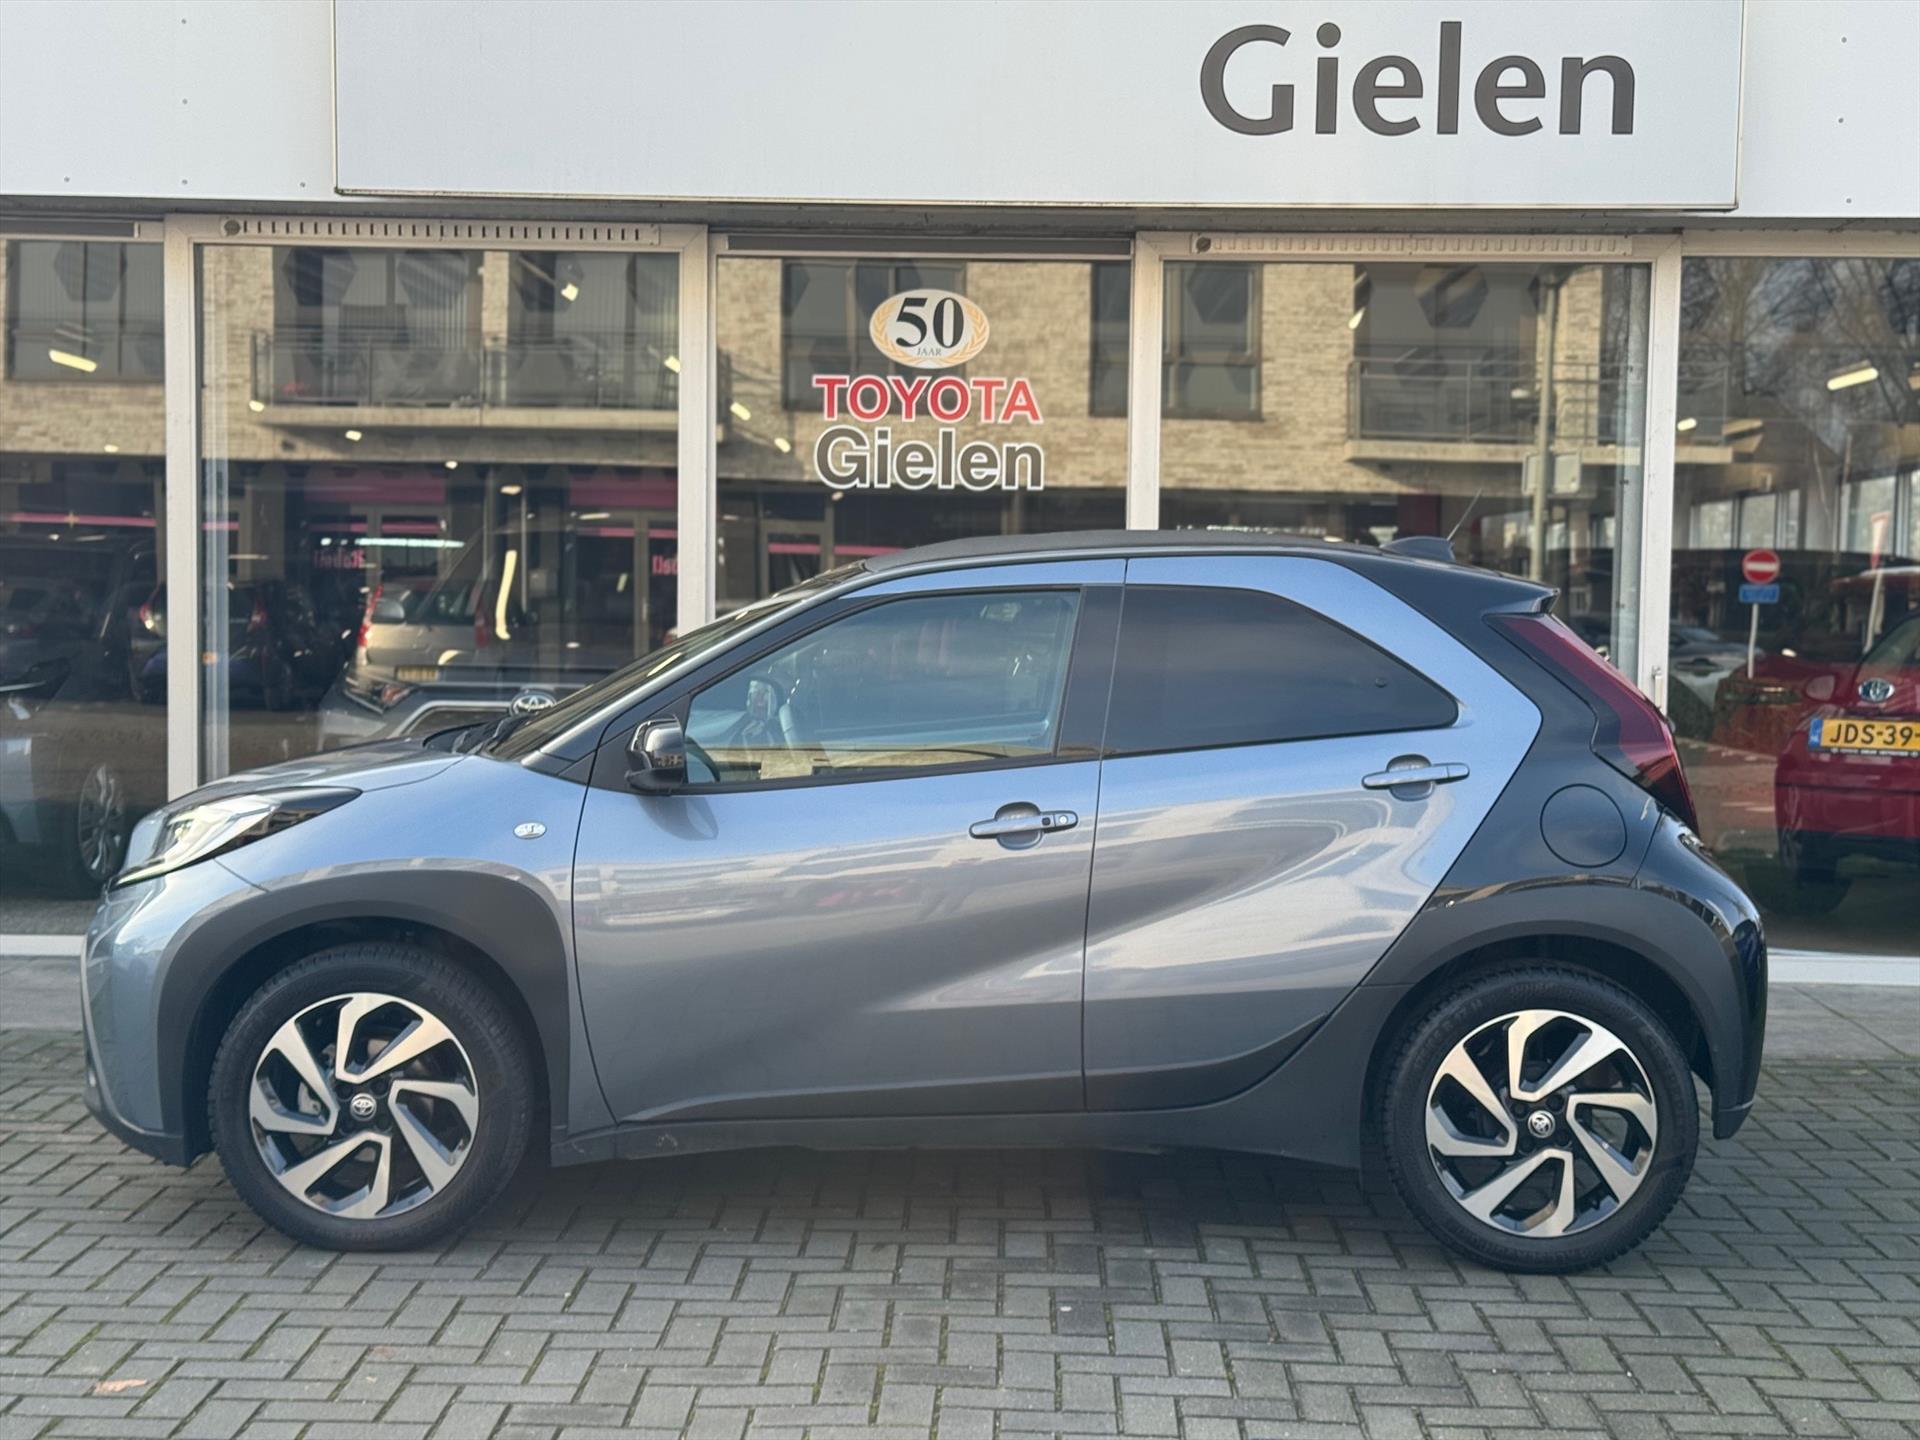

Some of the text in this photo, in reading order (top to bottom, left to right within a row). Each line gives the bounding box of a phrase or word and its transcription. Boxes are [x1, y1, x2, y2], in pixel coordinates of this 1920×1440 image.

[1200, 21, 1635, 136] Gielen
[895, 297, 964, 348] 50
[917, 347, 942, 357] JAAR
[813, 375, 1043, 423] TOYOTA
[815, 425, 1044, 490] Gielen
